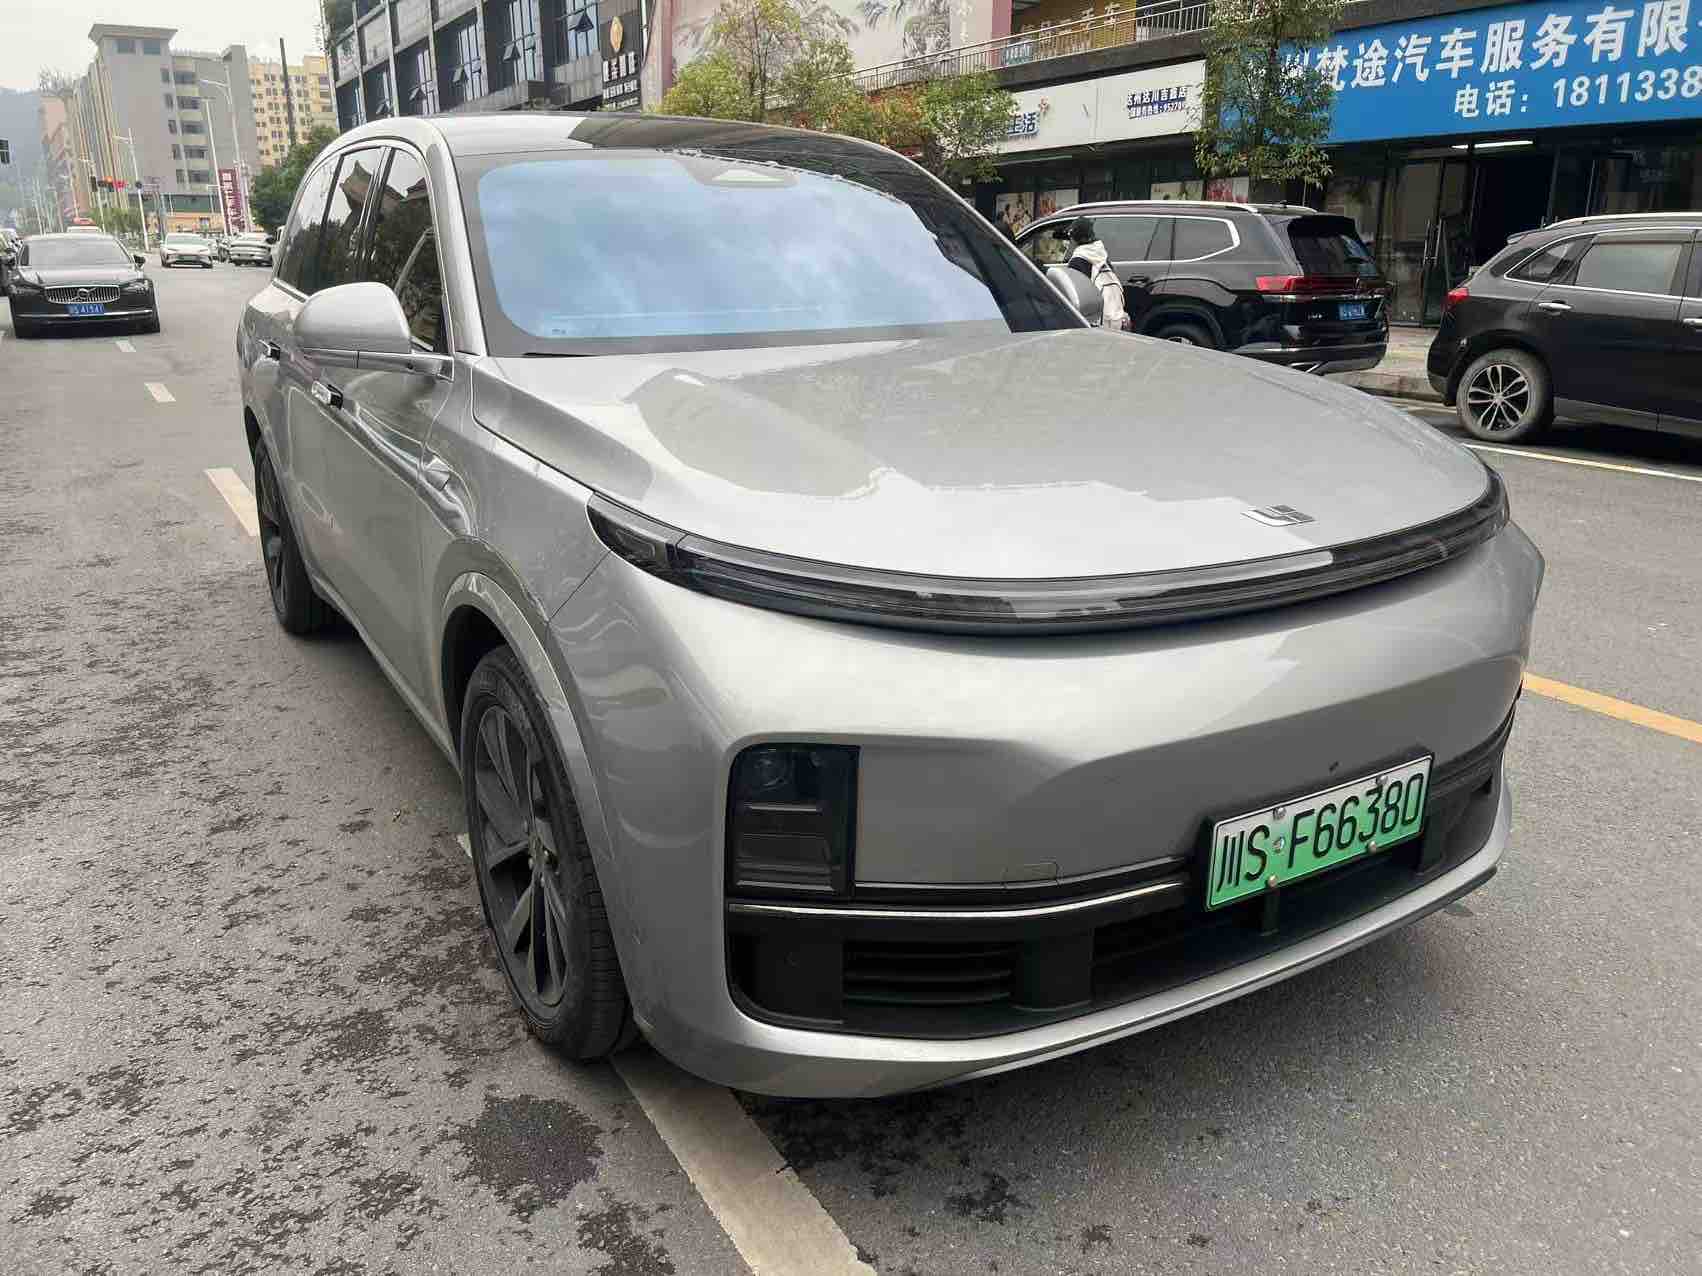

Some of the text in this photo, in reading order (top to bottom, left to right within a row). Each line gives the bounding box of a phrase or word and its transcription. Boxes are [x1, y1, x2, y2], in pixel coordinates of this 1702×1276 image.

[1283, 0, 1702, 93] 梵途汽车服务有限
[1553, 65, 1702, 108] 1811338
